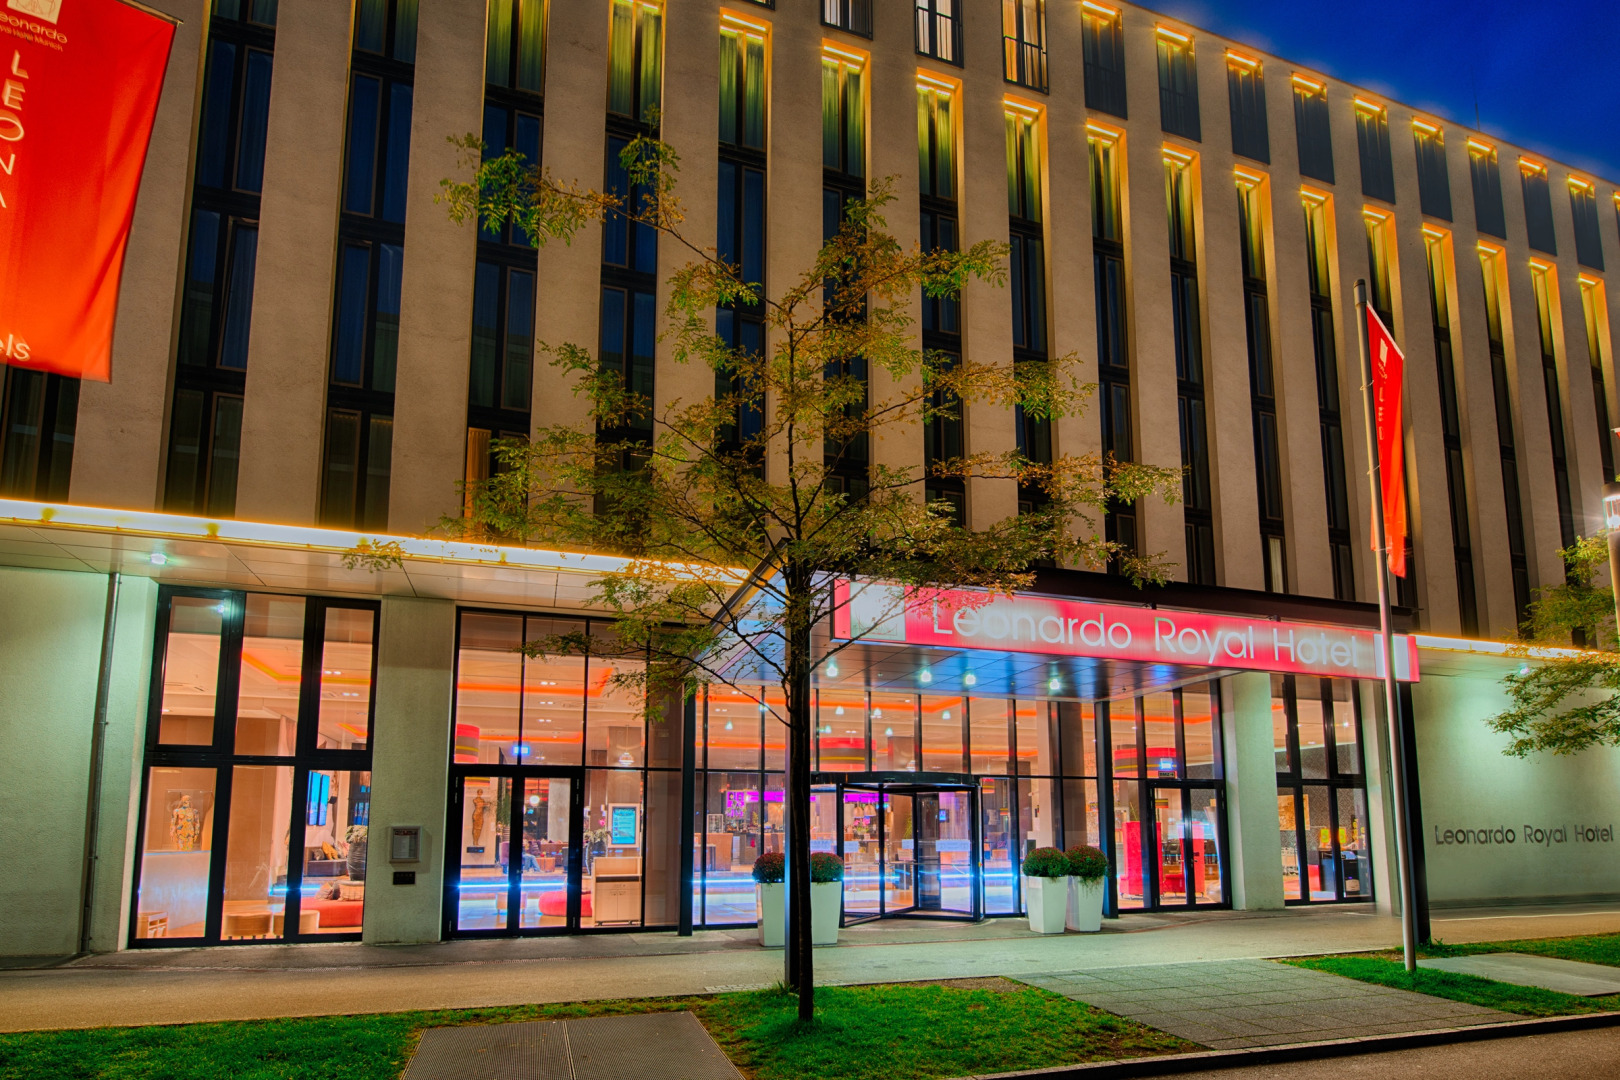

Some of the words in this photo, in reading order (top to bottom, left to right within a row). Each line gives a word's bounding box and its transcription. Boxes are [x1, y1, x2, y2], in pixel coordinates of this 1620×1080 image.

[933, 597, 1132, 649] Leonardo
[1154, 617, 1255, 664] Royal
[1273, 628, 1357, 667] Hotel
[1434, 825, 1516, 845] Leonardo
[1524, 824, 1568, 847] Royal
[1574, 824, 1614, 842] Hotel
